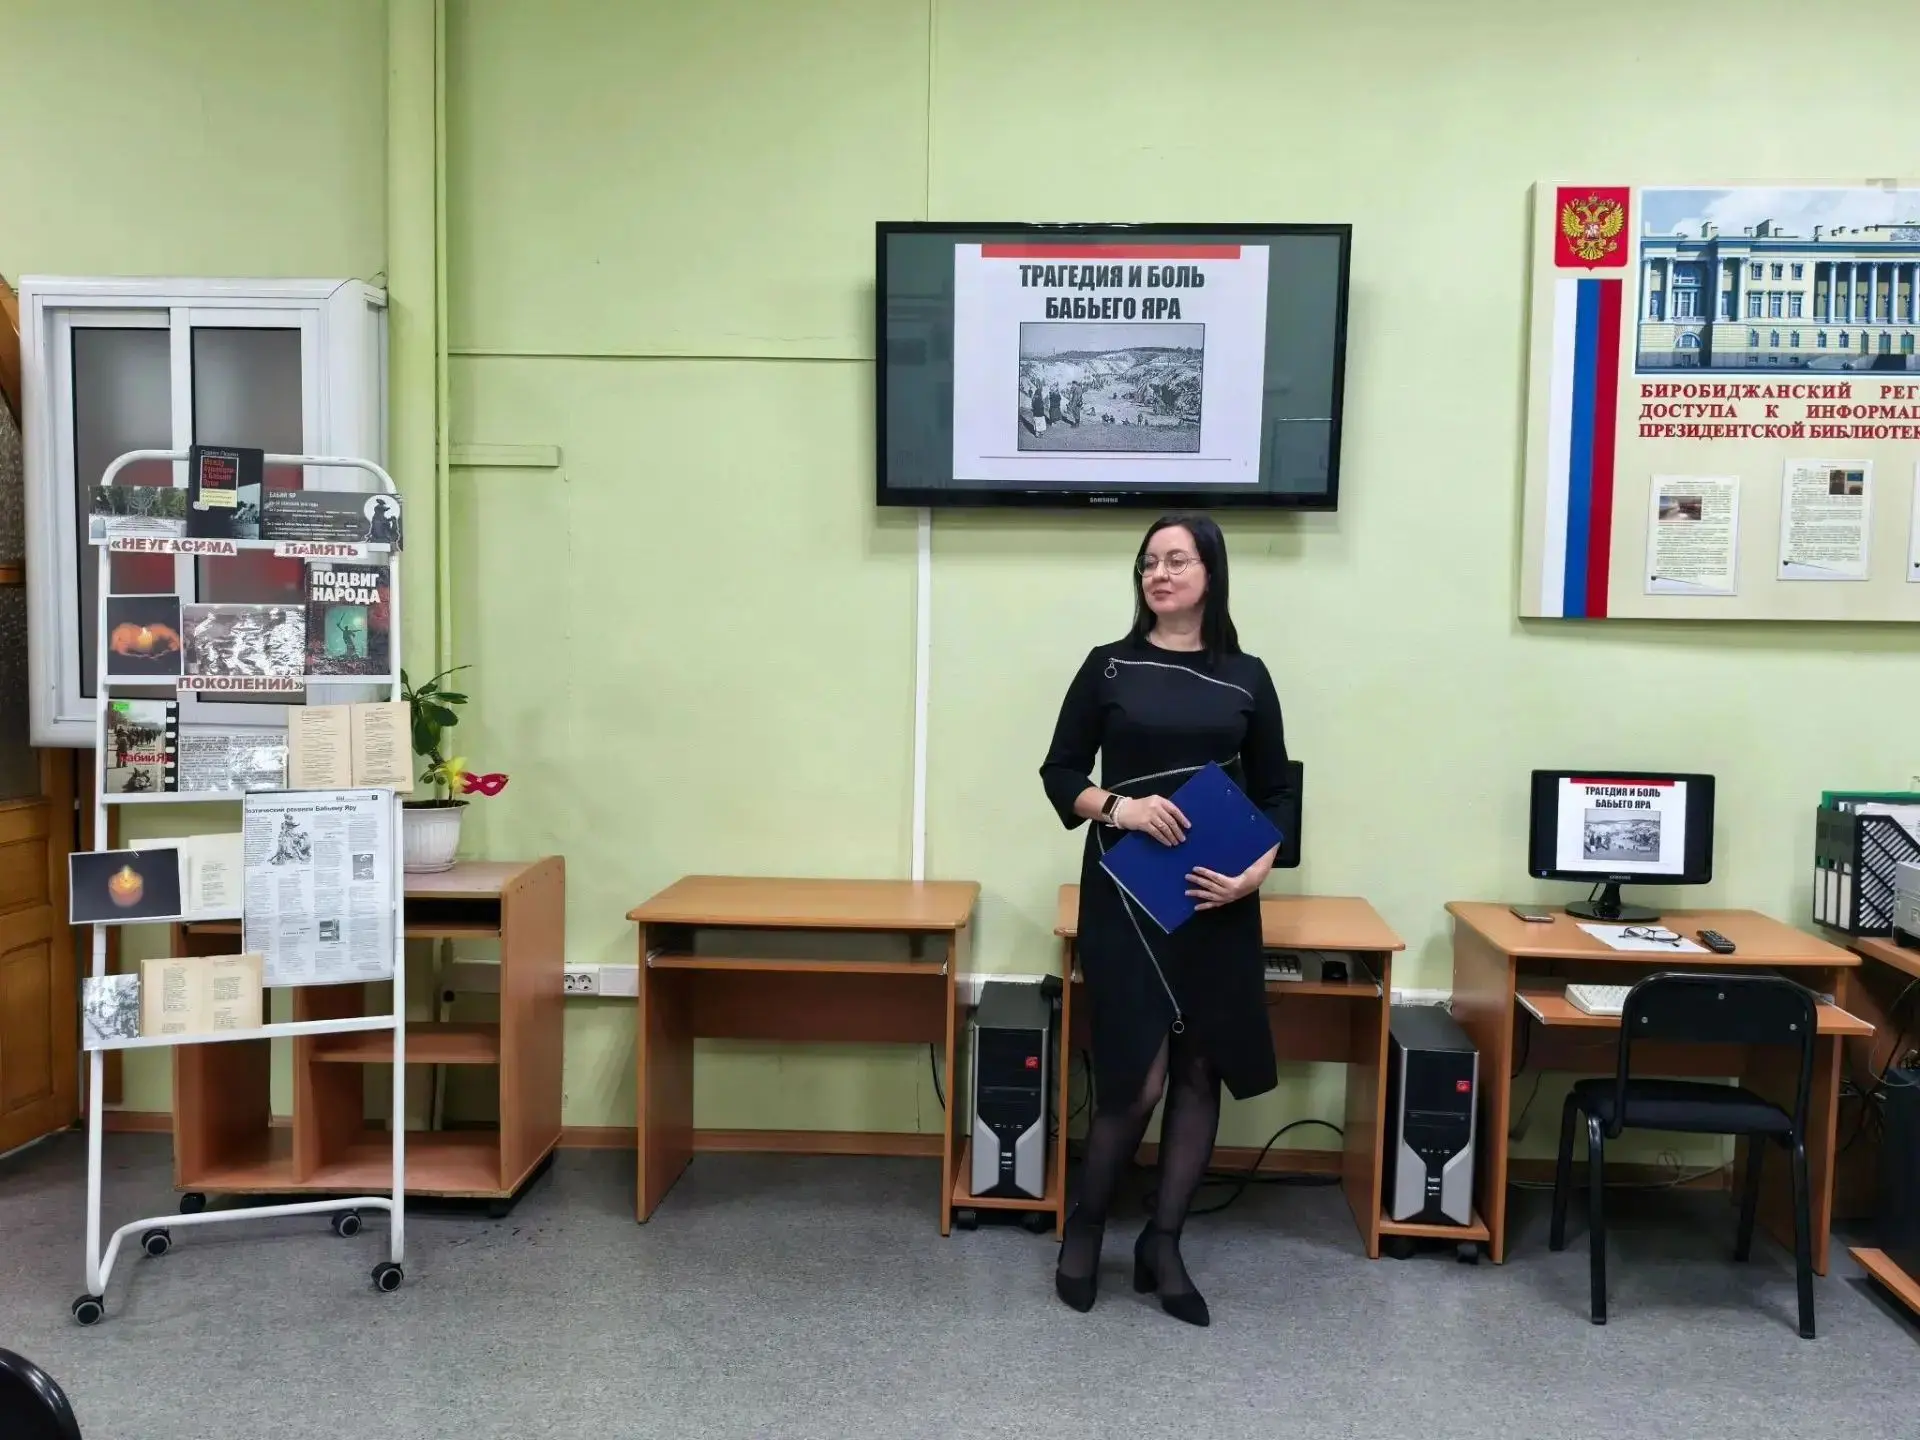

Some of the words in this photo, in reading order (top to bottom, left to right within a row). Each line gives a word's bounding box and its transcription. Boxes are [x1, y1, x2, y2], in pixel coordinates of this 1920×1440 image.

[1019, 264, 1123, 291] ТРАГЕДИЯ
[1128, 265, 1142, 288] И
[1147, 265, 1205, 288] БОЛЬ
[1045, 297, 1137, 320] БАБЬЕГО
[1141, 297, 1182, 320] ЯРА
[1640, 381, 1852, 401] БИРОБИДЖАНСКИЙ
[1880, 384, 1919, 400] РЕГ
[1638, 403, 1738, 420] ДОСТУПА
[1765, 404, 1779, 418] К
[1638, 421, 1804, 440] ПРЕЗИДЕНТСКОЙ
[111, 537, 234, 554] «НЕУГАСИМА
[284, 542, 359, 556] ПАМЯТЬ
[312, 571, 380, 588] ПОДВИГ
[312, 587, 381, 605] НАРОДА
[178, 675, 305, 691] ПОКОЛЕНИЙ»
[1585, 786, 1628, 797] ТРАГЕДИЯ
[1629, 787, 1635, 797] И
[1637, 787, 1661, 798] БОЛЬ
[1595, 799, 1633, 809] БАБЬЕГО
[1634, 799, 1651, 809] ЯРА
